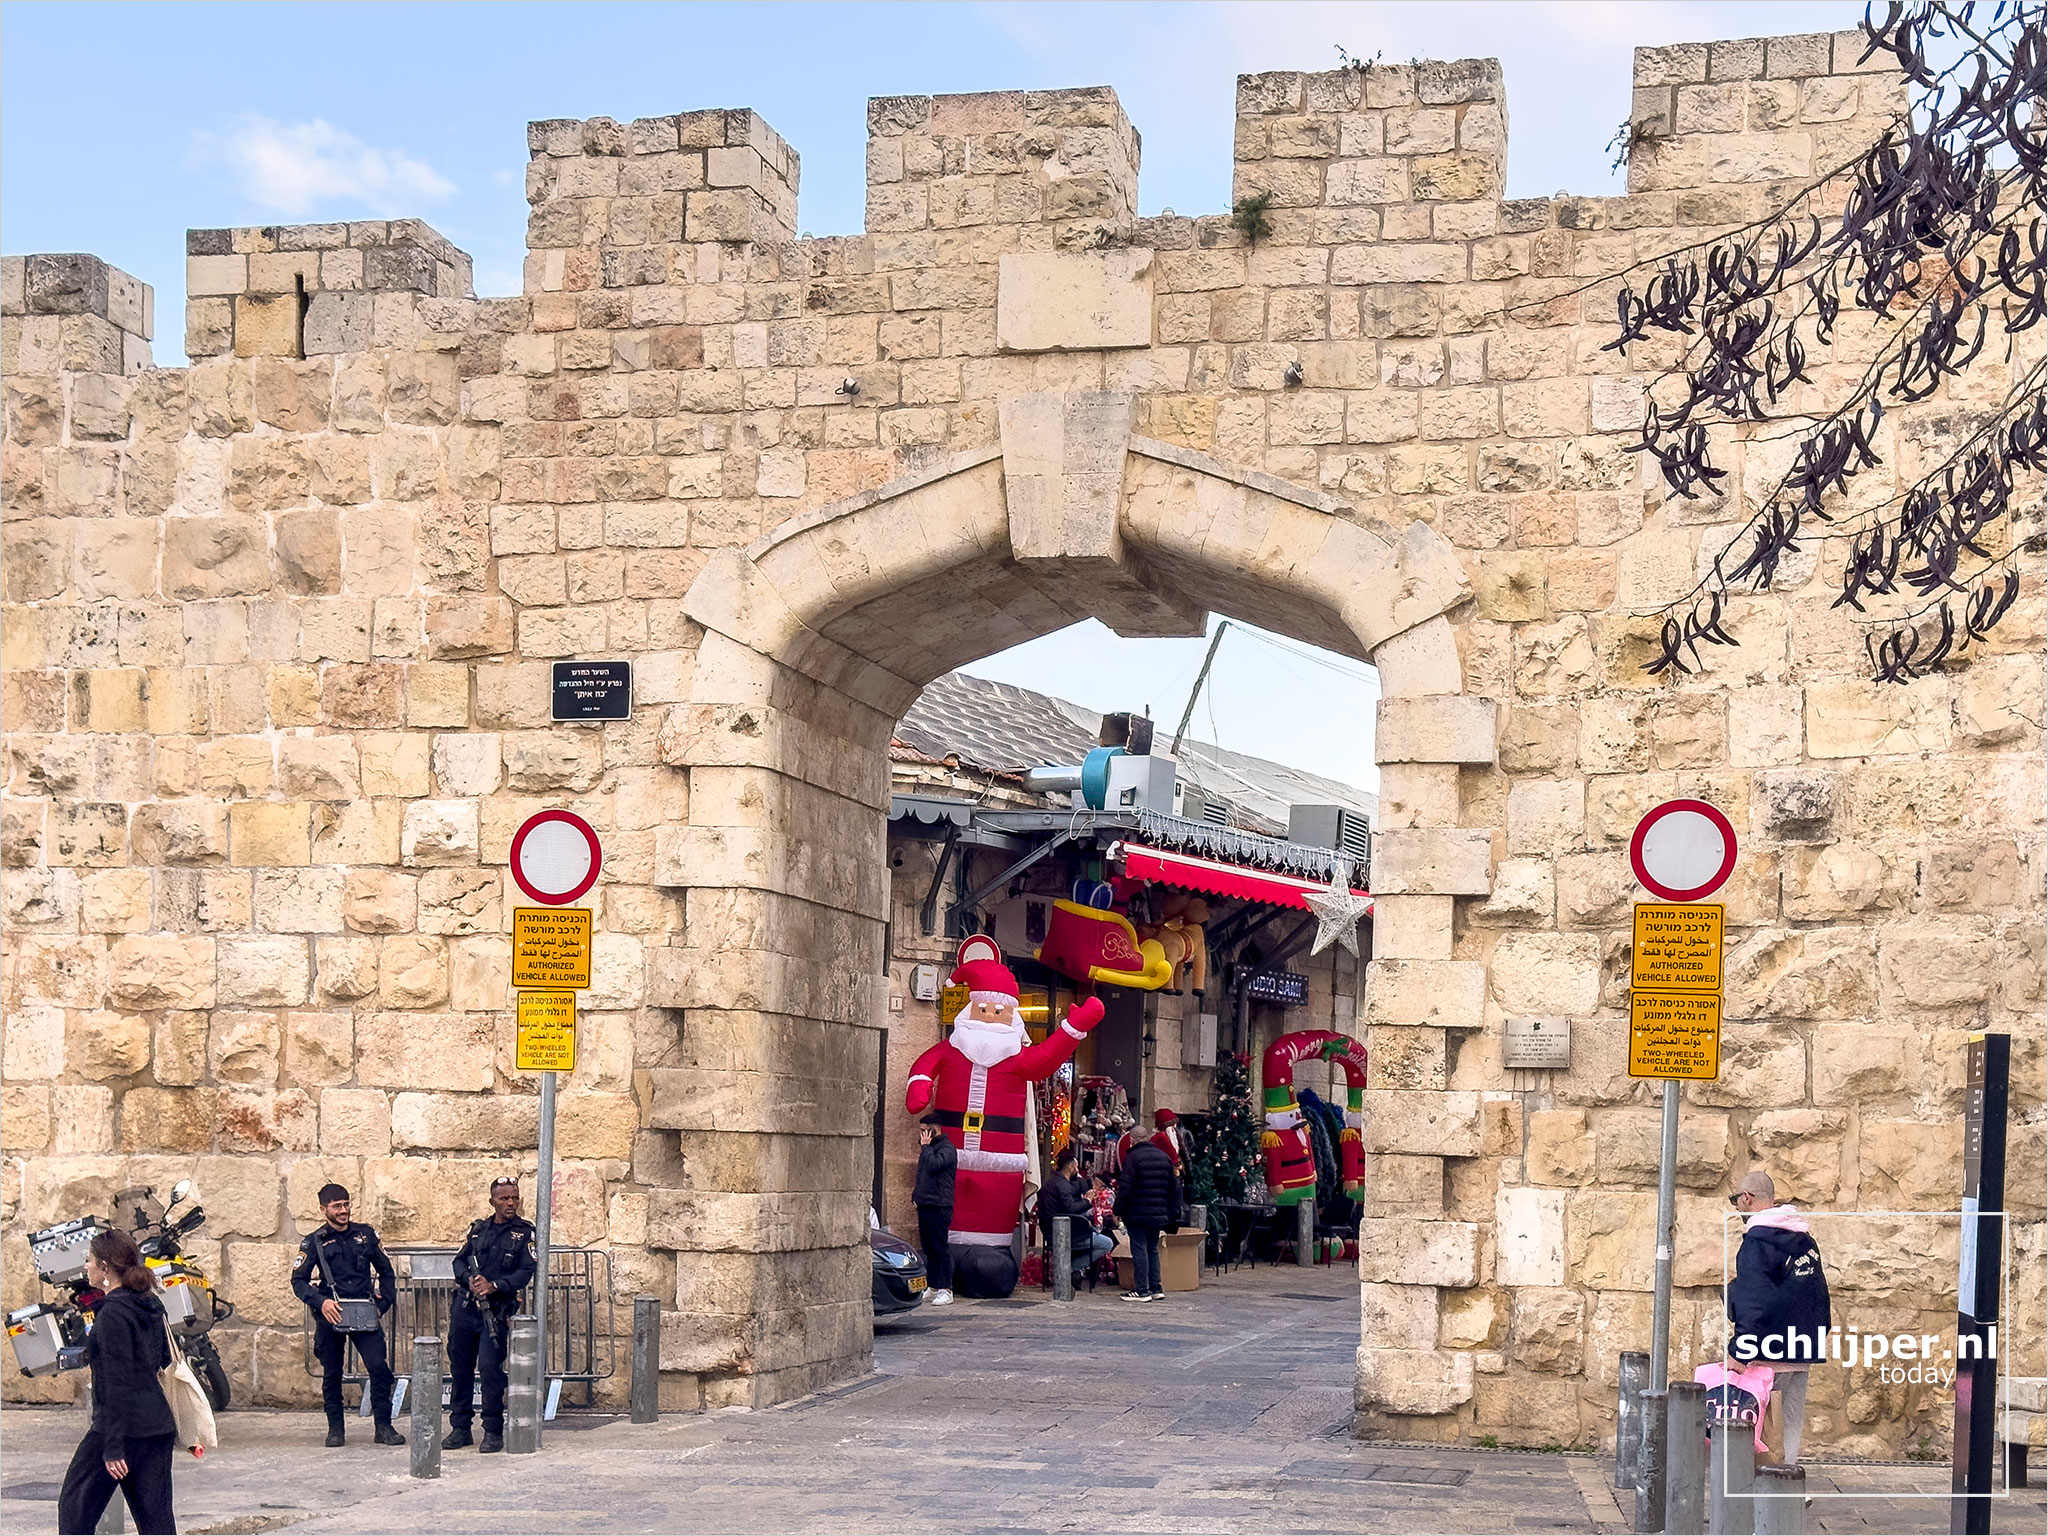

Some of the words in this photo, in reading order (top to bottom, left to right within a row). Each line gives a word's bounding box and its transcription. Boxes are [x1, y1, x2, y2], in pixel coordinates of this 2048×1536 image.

[553, 915, 586, 923] הכניסה
[558, 926, 581, 934] לרכב
[1685, 923, 1711, 932] לרכב
[525, 938, 556, 947] للمركبات
[1646, 936, 1683, 946] للمركبات
[521, 948, 537, 956] فقط
[540, 950, 550, 958] لها
[552, 951, 581, 959] المصرح
[1642, 947, 1661, 955] فقط
[1664, 948, 1675, 958] لها
[1678, 949, 1711, 959] المصرح
[550, 973, 586, 981] ALLOWED
[1637, 973, 1671, 981] VEHICLE
[1675, 974, 1716, 982] ALLOWED
[1241, 973, 1275, 993] UDIO
[554, 997, 572, 1005] אסורה
[1636, 998, 1657, 1006] לרכב
[1660, 1000, 1685, 1008] כניסה
[1688, 1001, 1716, 1009] אסורה
[1644, 1011, 1671, 1019] ממונע
[1674, 1011, 1696, 1020] גלגלי
[1699, 1013, 1707, 1021] דו
[1634, 1024, 1665, 1034] المركبات
[1691, 1026, 1715, 1036] ممنوع
[1647, 1037, 1680, 1046] العجلتين
[1683, 1037, 1701, 1048] ذوات
[1643, 1050, 1704, 1058] TWO-WHEELED
[1637, 1057, 1670, 1065] VEHICLE
